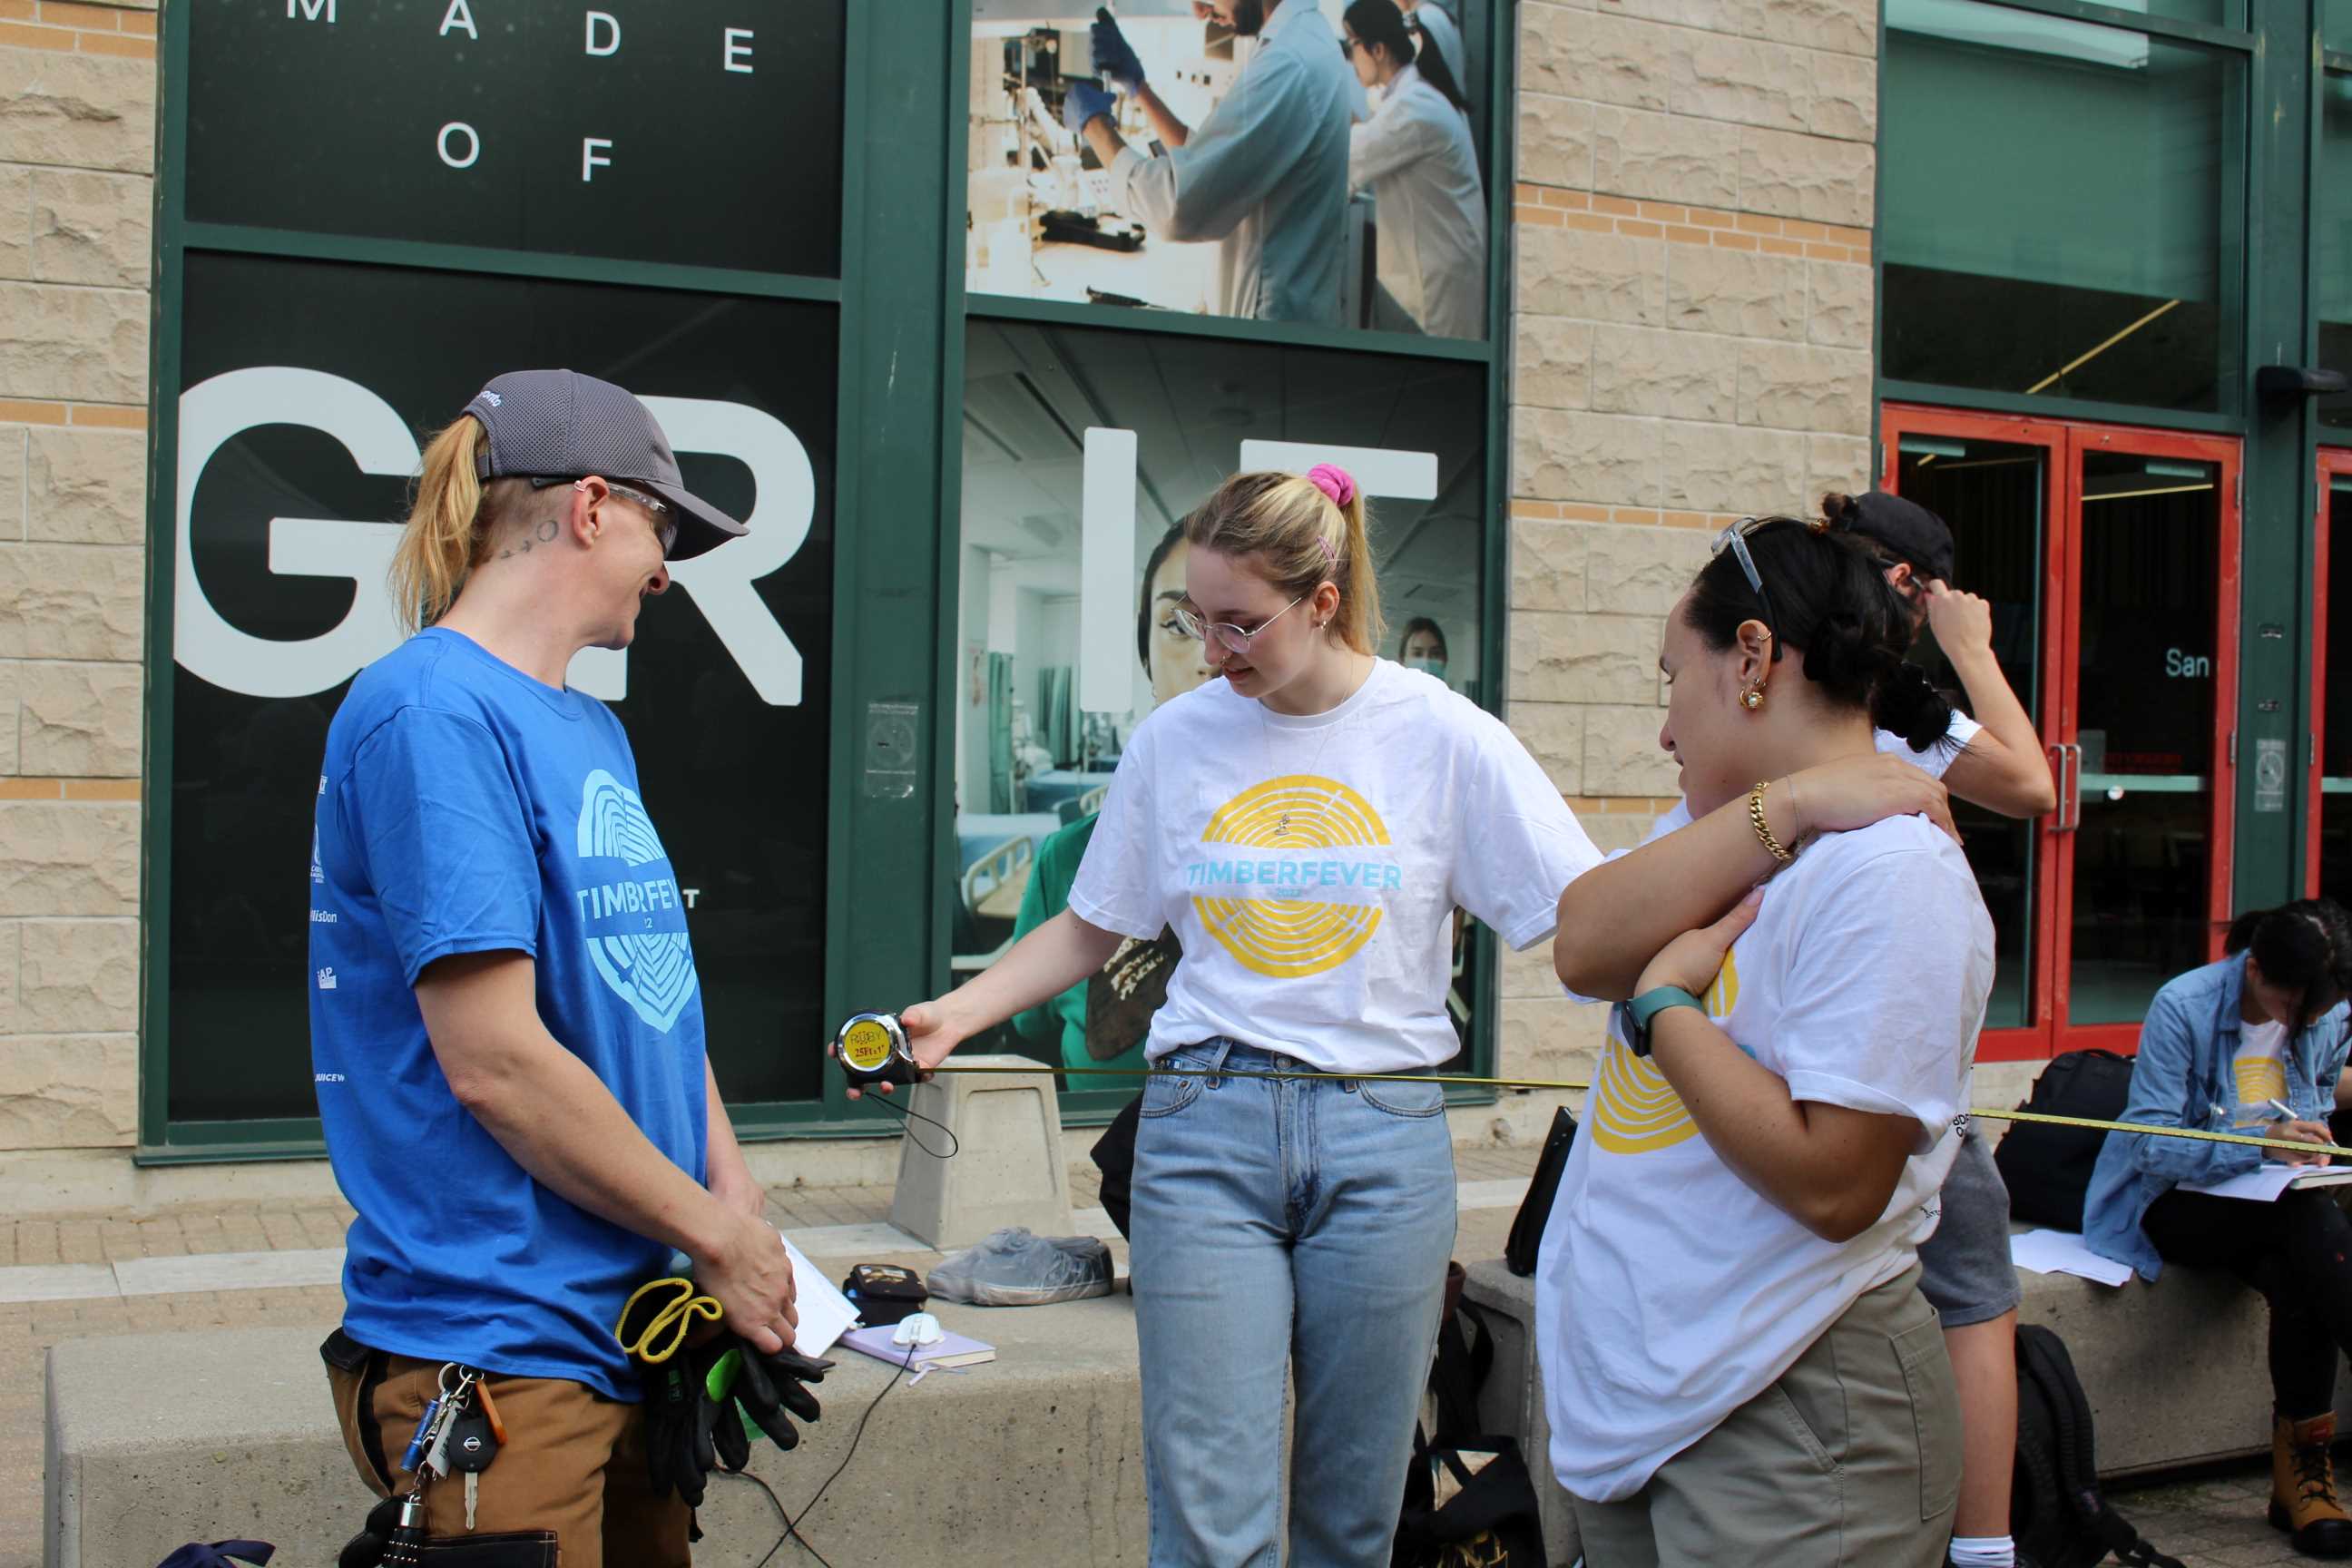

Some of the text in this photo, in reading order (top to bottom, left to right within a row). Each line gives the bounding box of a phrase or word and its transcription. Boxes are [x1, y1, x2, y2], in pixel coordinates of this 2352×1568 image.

[437, 122, 612, 181] OF
[2166, 648, 2210, 678] San
[1188, 860, 1402, 891] TIMBERFEVER
[309, 908, 338, 924] llisDon
